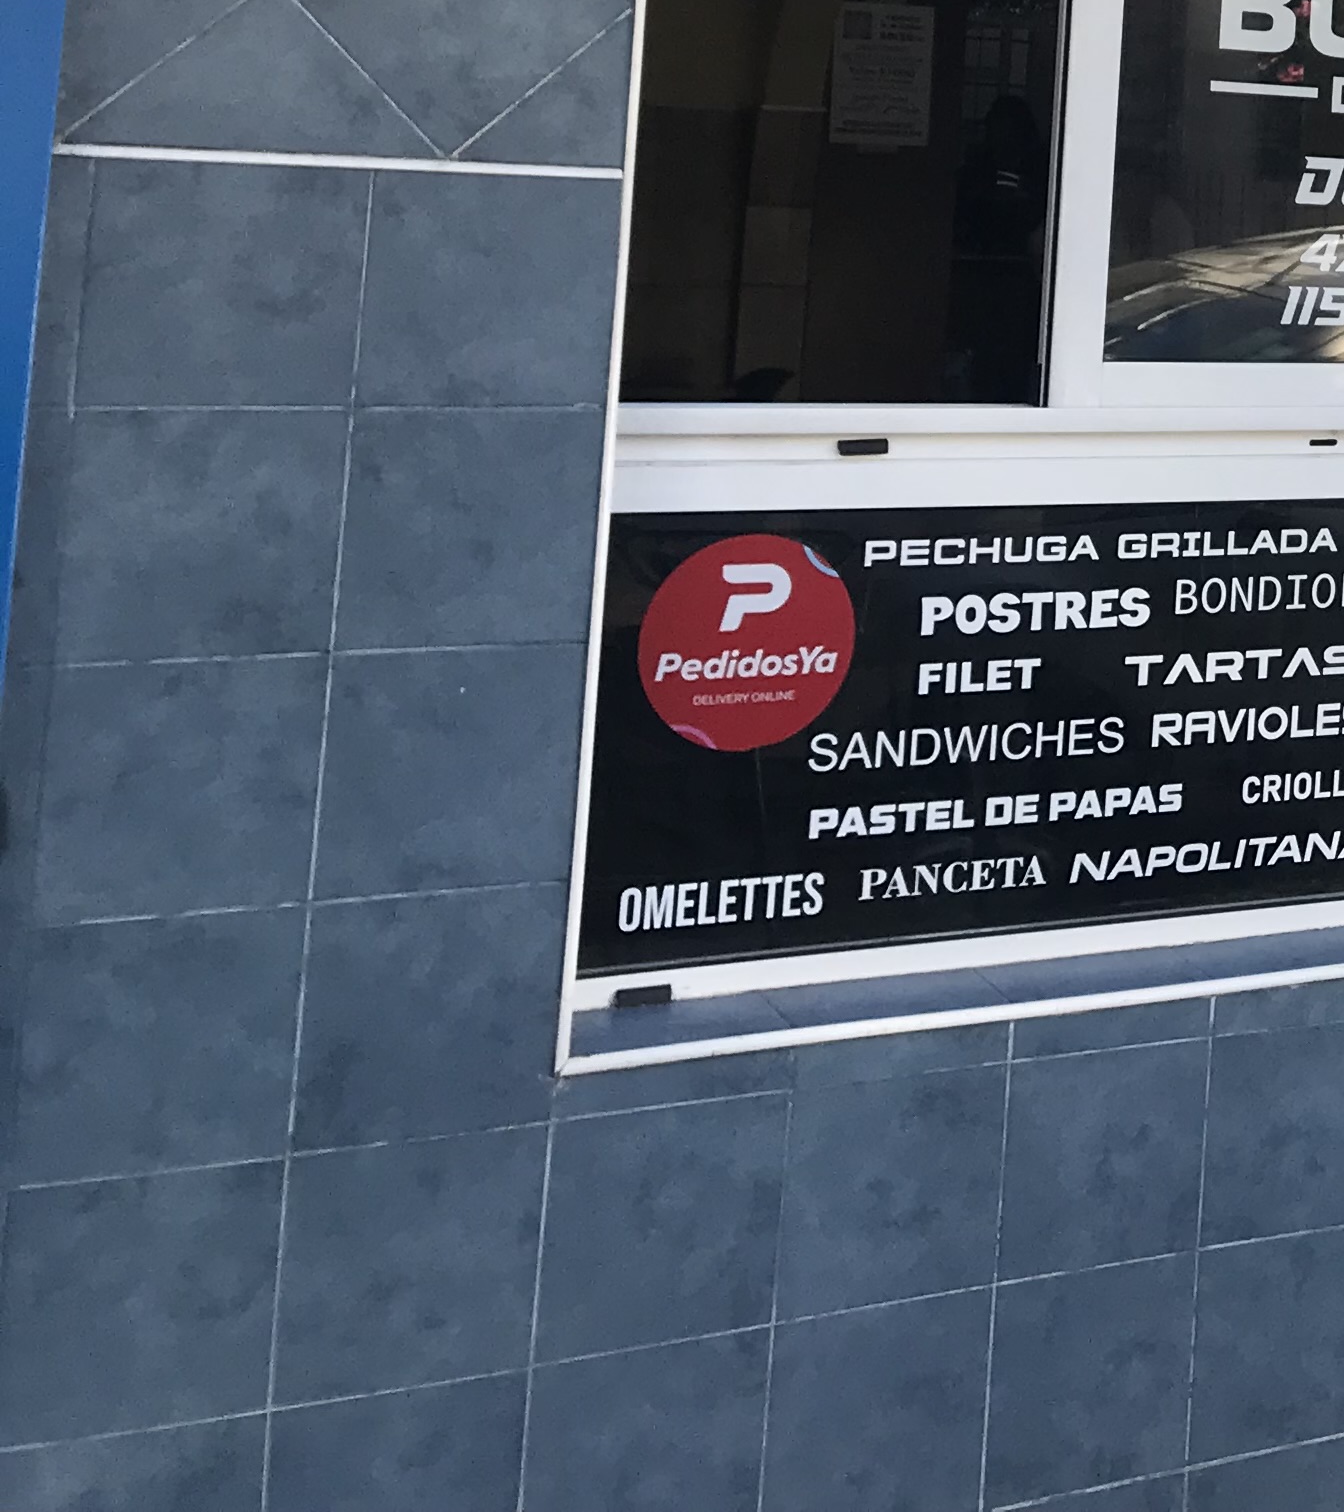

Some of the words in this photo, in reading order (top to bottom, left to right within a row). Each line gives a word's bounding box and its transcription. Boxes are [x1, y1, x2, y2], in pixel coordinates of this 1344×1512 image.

[864, 535, 1099, 568] PECHUGA
[1117, 527, 1338, 561] GRILLADA
[919, 587, 1151, 637] POSTRES
[654, 645, 838, 682] PedidosYa
[917, 657, 1041, 695] FILET
[692, 692, 749, 706] DELIVERY
[751, 690, 796, 704] ONLINE
[808, 715, 1124, 773] SANDWICHES
[808, 799, 975, 840] PASTEL
[985, 794, 1038, 826] DE
[1048, 782, 1184, 822] PAPAS
[618, 871, 825, 932] OMELETTES
[858, 853, 1045, 902] PANCETA
